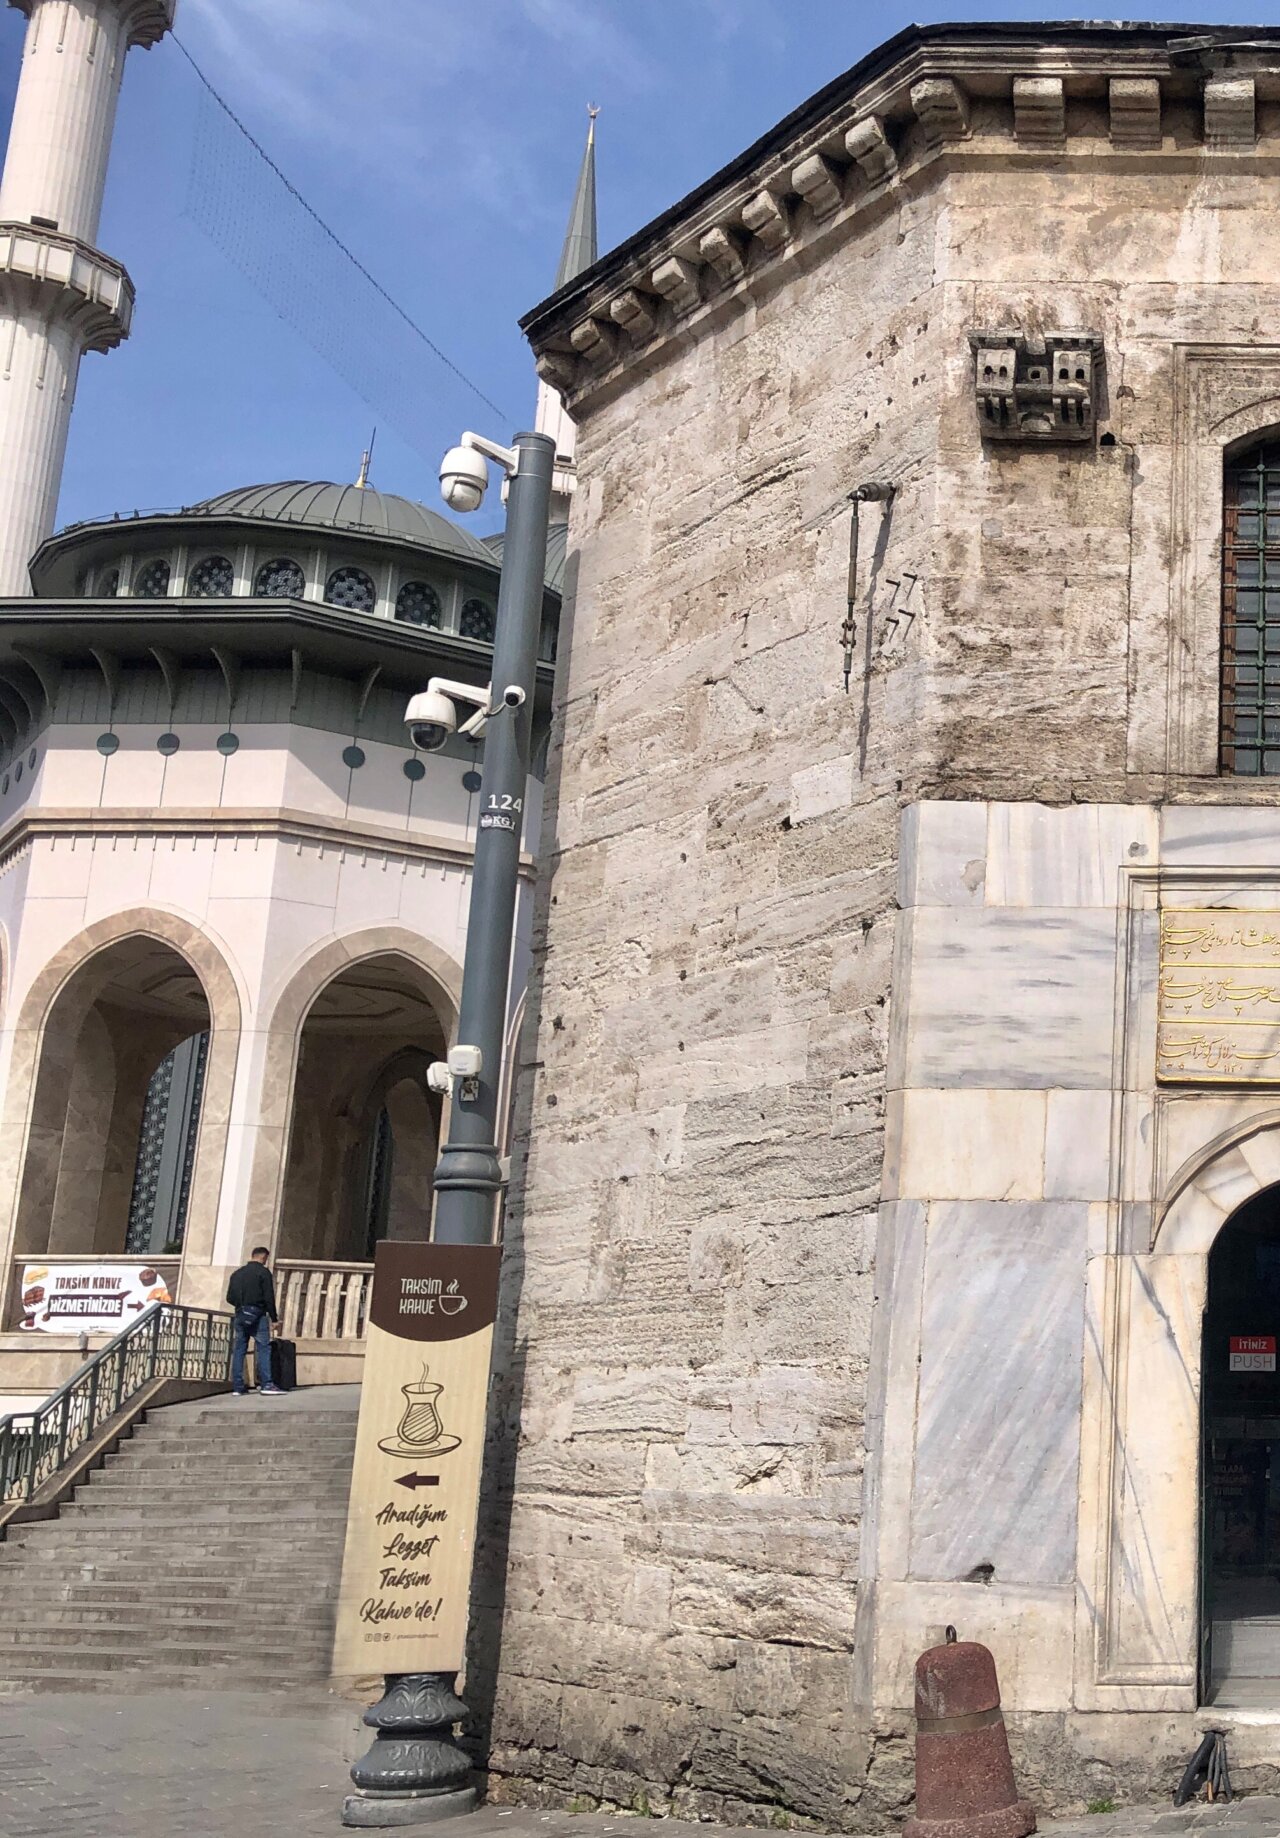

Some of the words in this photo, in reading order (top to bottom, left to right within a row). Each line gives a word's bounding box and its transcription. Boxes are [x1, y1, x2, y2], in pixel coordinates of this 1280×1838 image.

[488, 794, 522, 813] 124
[55, 1275, 90, 1290] TAKSİM
[92, 1277, 122, 1290] KAHVE
[401, 1277, 442, 1295] TAKSİM
[50, 1297, 121, 1313] HİZMETİNİZDE
[1233, 1355, 1273, 1368] PUSH
[375, 1501, 448, 1529] Aradığım
[383, 1533, 440, 1561] Lezzet
[379, 1567, 432, 1590] Taksim
[360, 1598, 443, 1624] Kahve'de!
